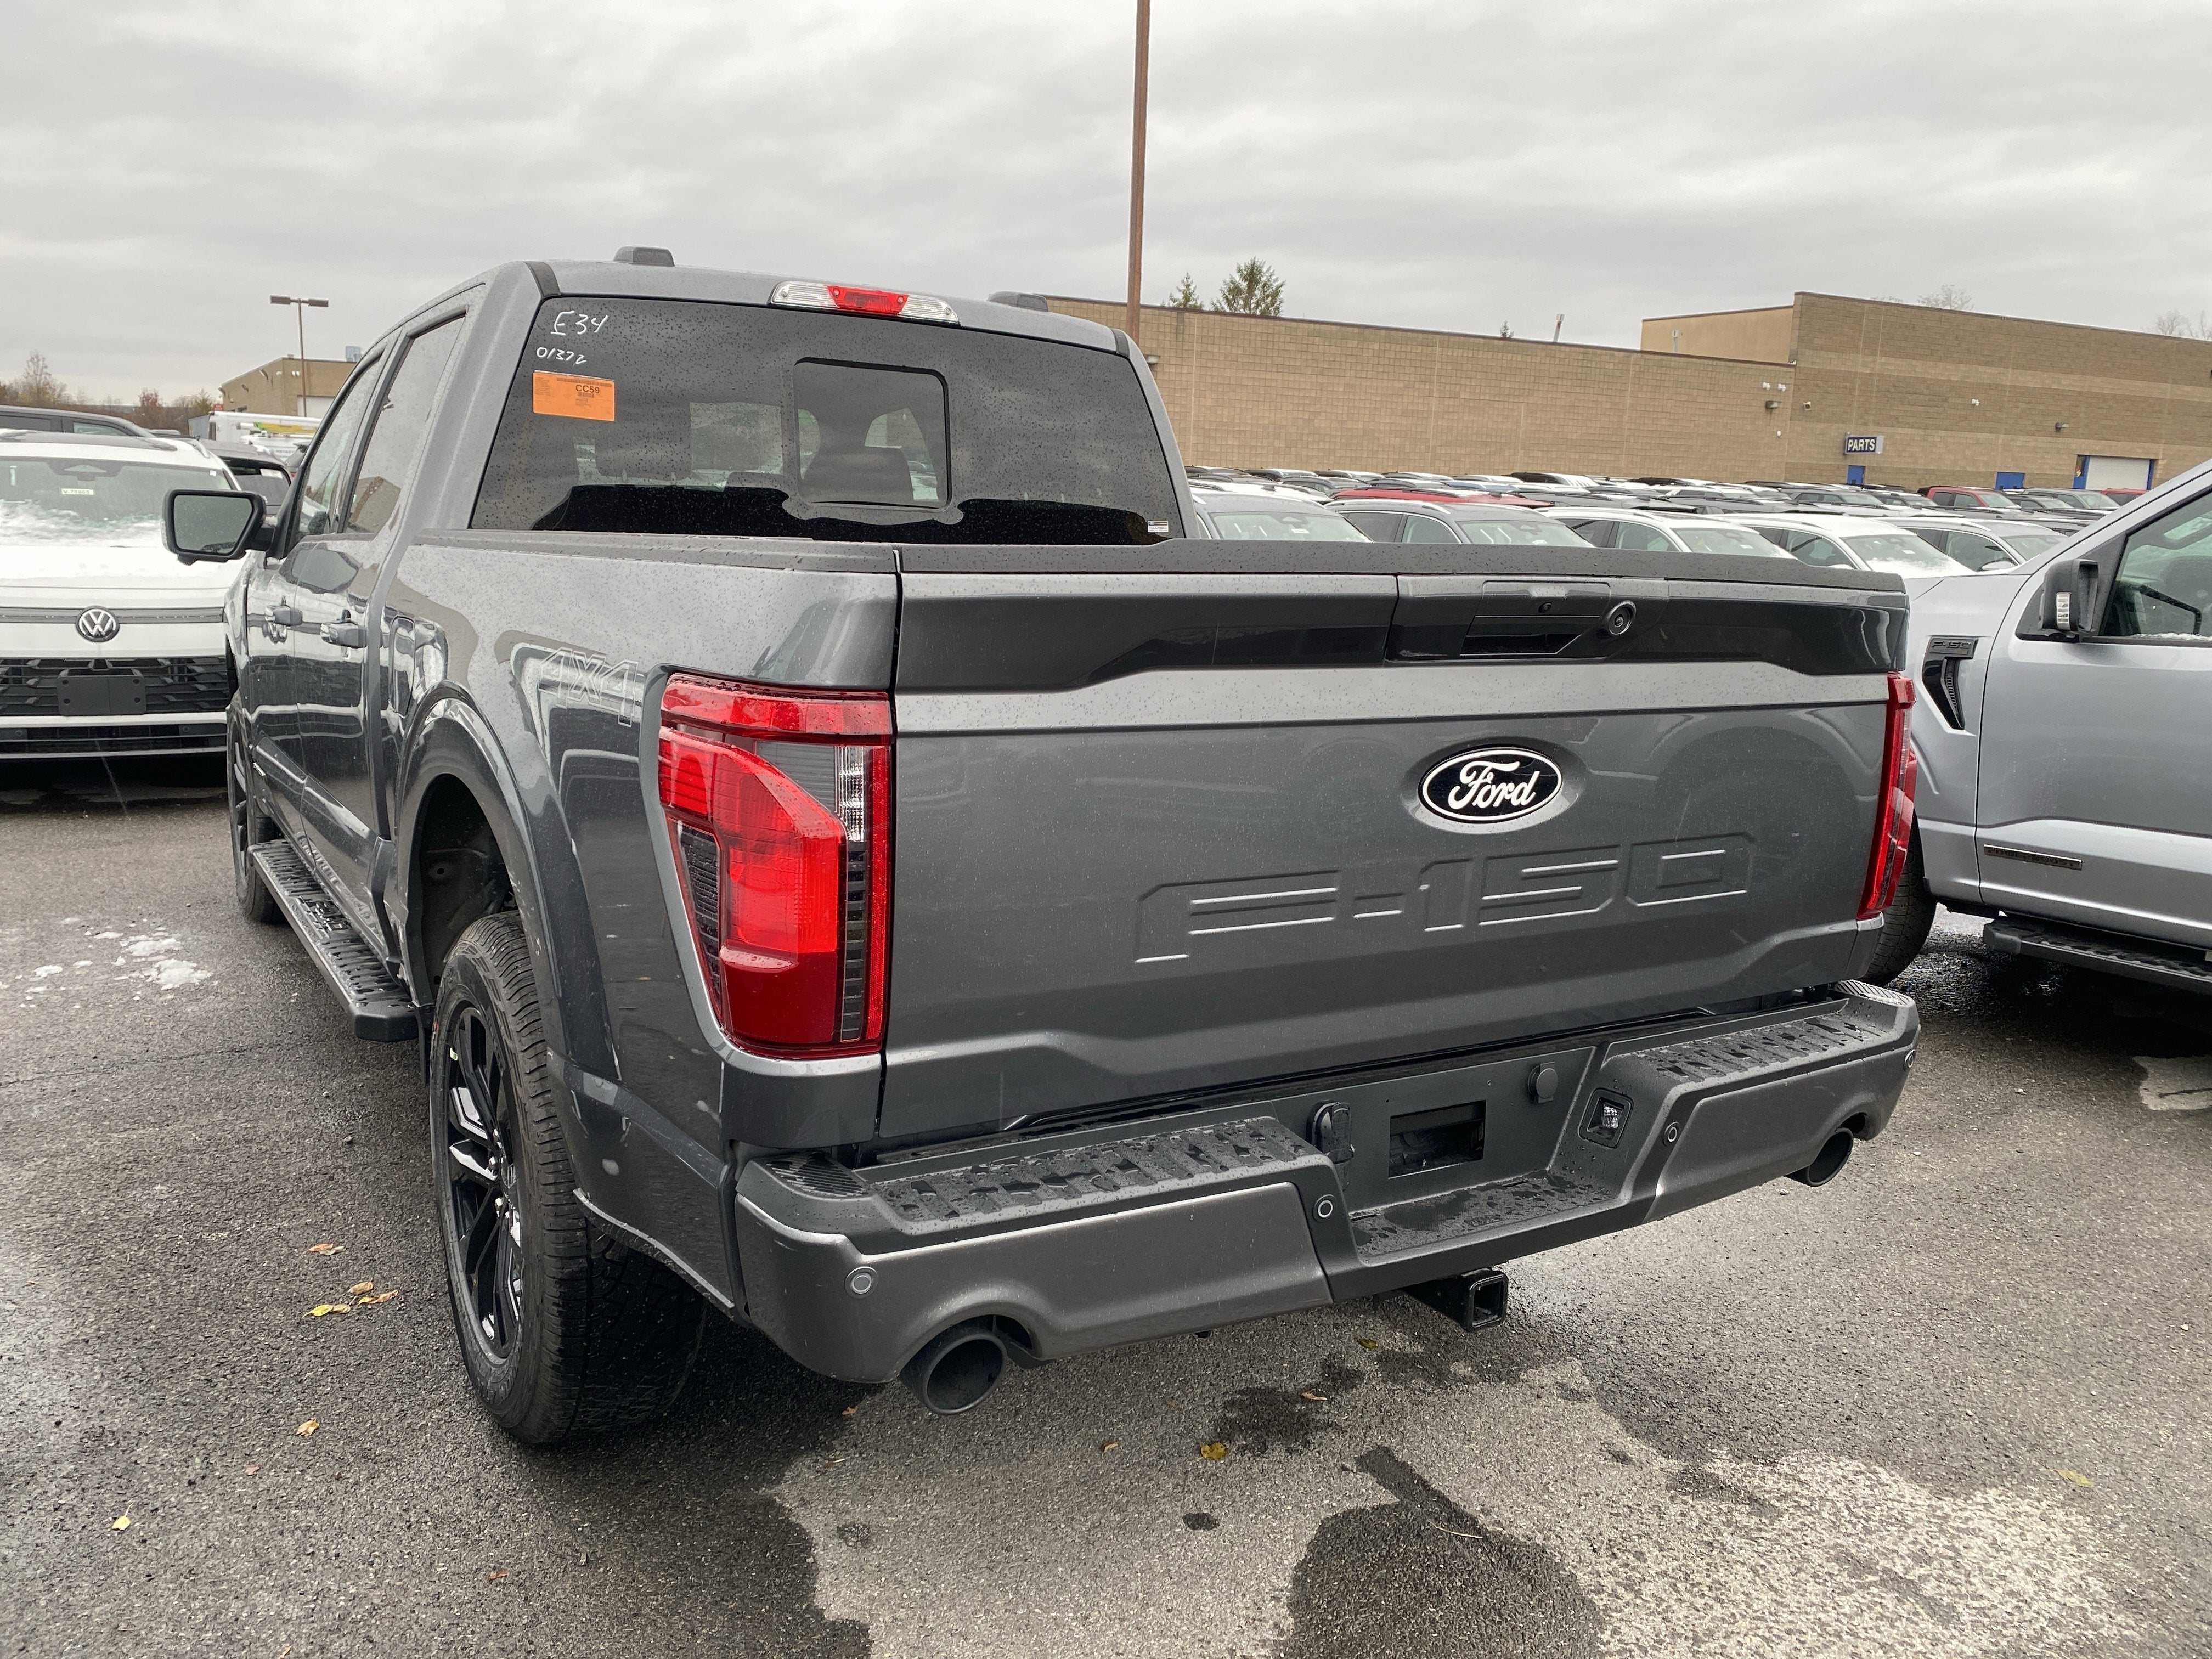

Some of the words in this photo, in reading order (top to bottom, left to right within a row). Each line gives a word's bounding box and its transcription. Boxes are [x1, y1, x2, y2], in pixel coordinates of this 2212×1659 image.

[550, 310, 608, 336] E34
[575, 384, 600, 394] CC59
[1847, 438, 1876, 452] PARTS
[1931, 640, 1971, 649] F-150
[1448, 760, 1541, 810] Ford
[1135, 831, 1756, 964] F-150
